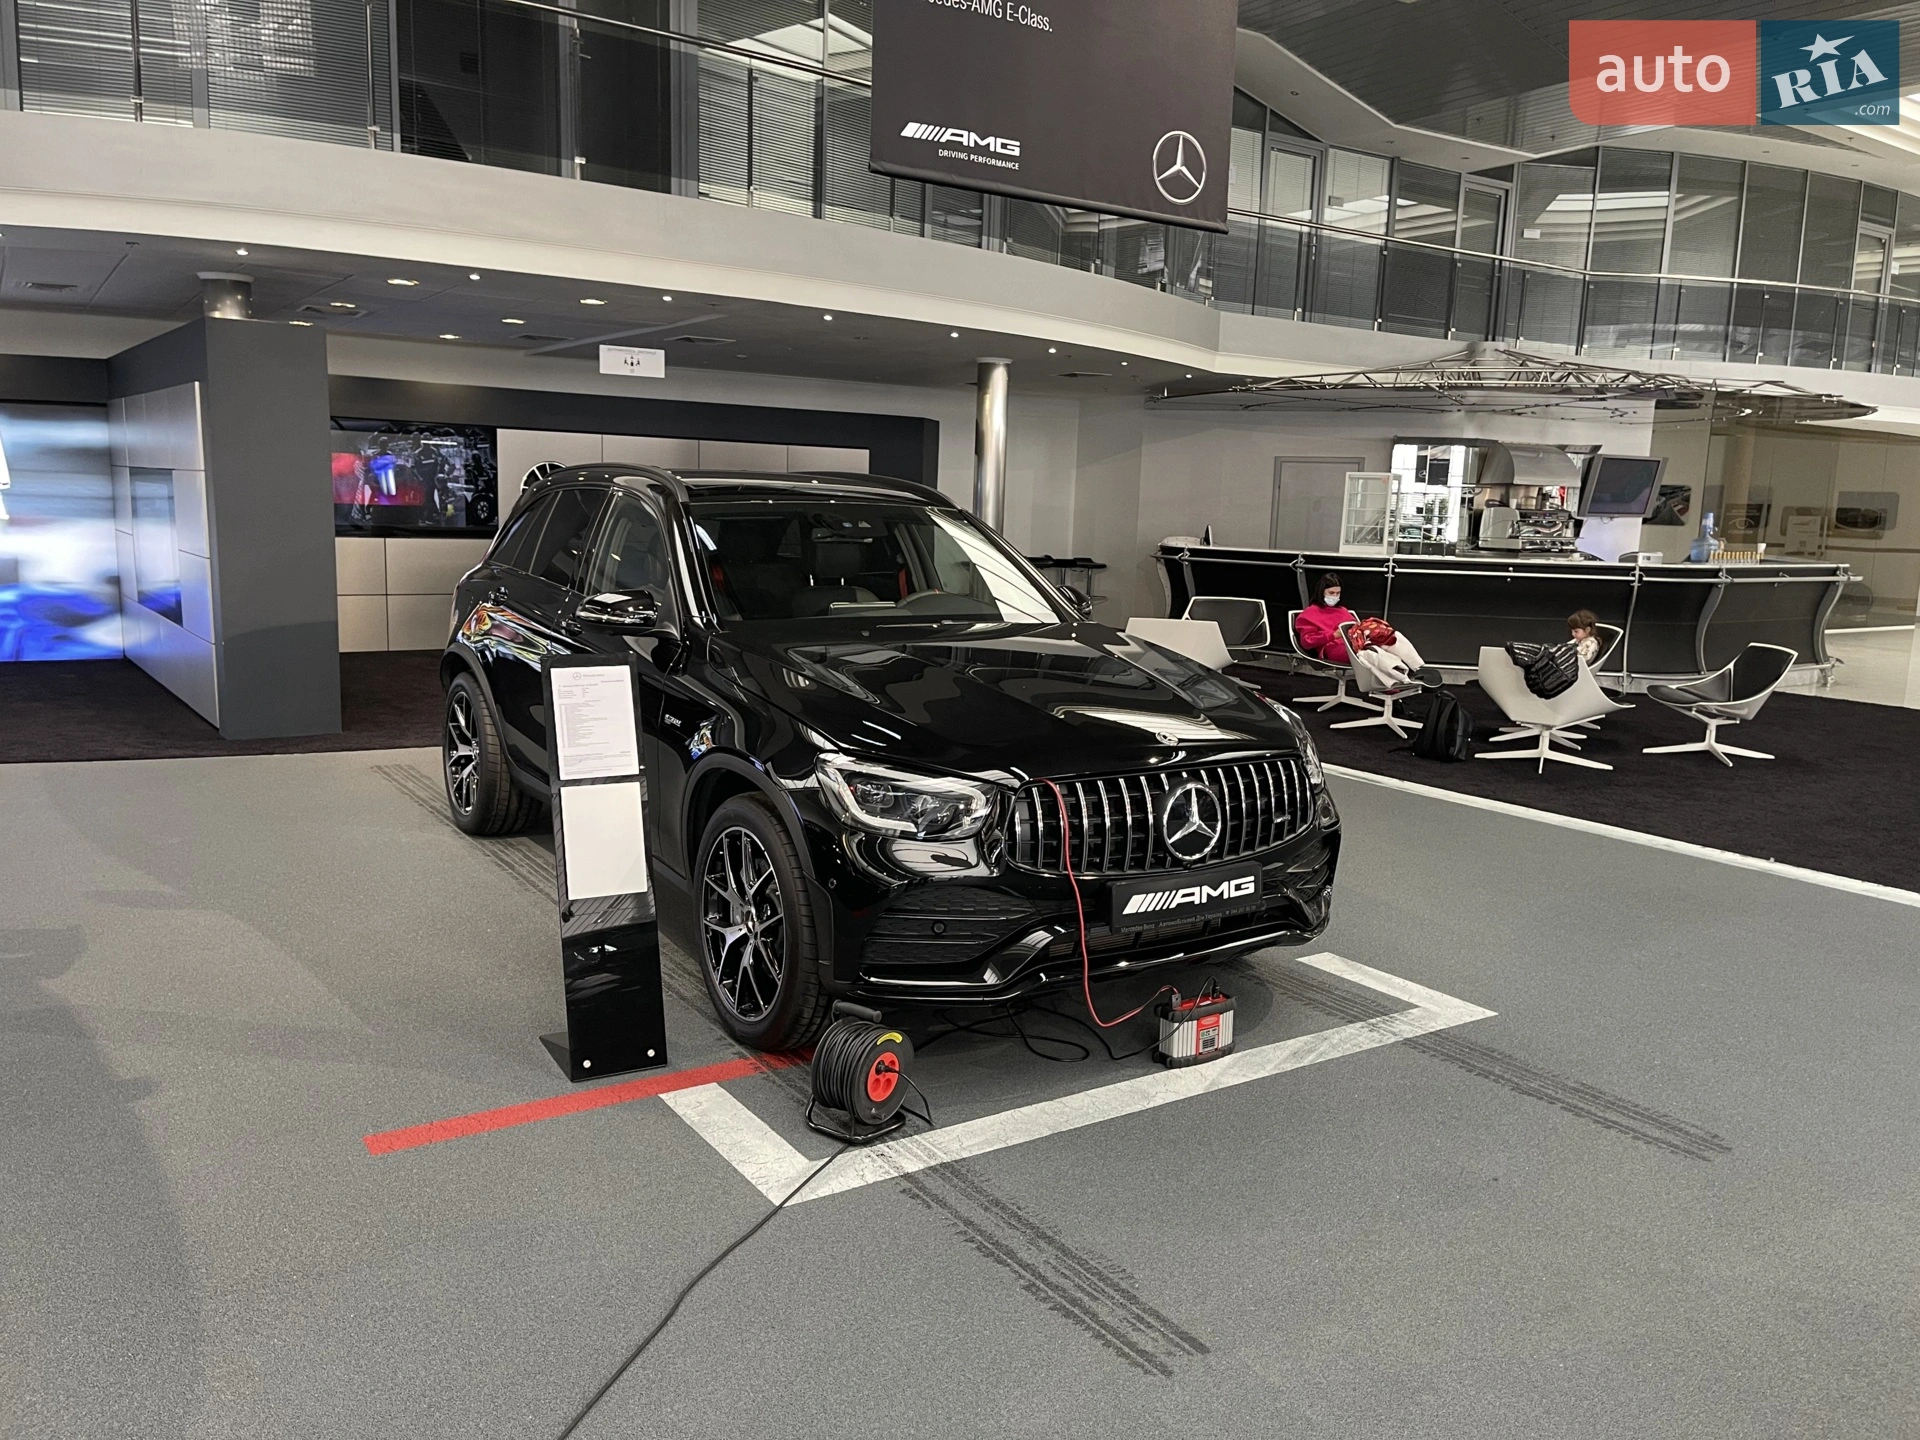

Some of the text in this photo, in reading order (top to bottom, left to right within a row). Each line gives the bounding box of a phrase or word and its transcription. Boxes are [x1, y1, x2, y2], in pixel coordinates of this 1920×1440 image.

[1006, 2, 1053, 32] E-Class.
[939, 128, 1020, 157] AMG
[938, 149, 1020, 170] DRIVING PERFORMANCE
[1168, 875, 1255, 909] AMG
